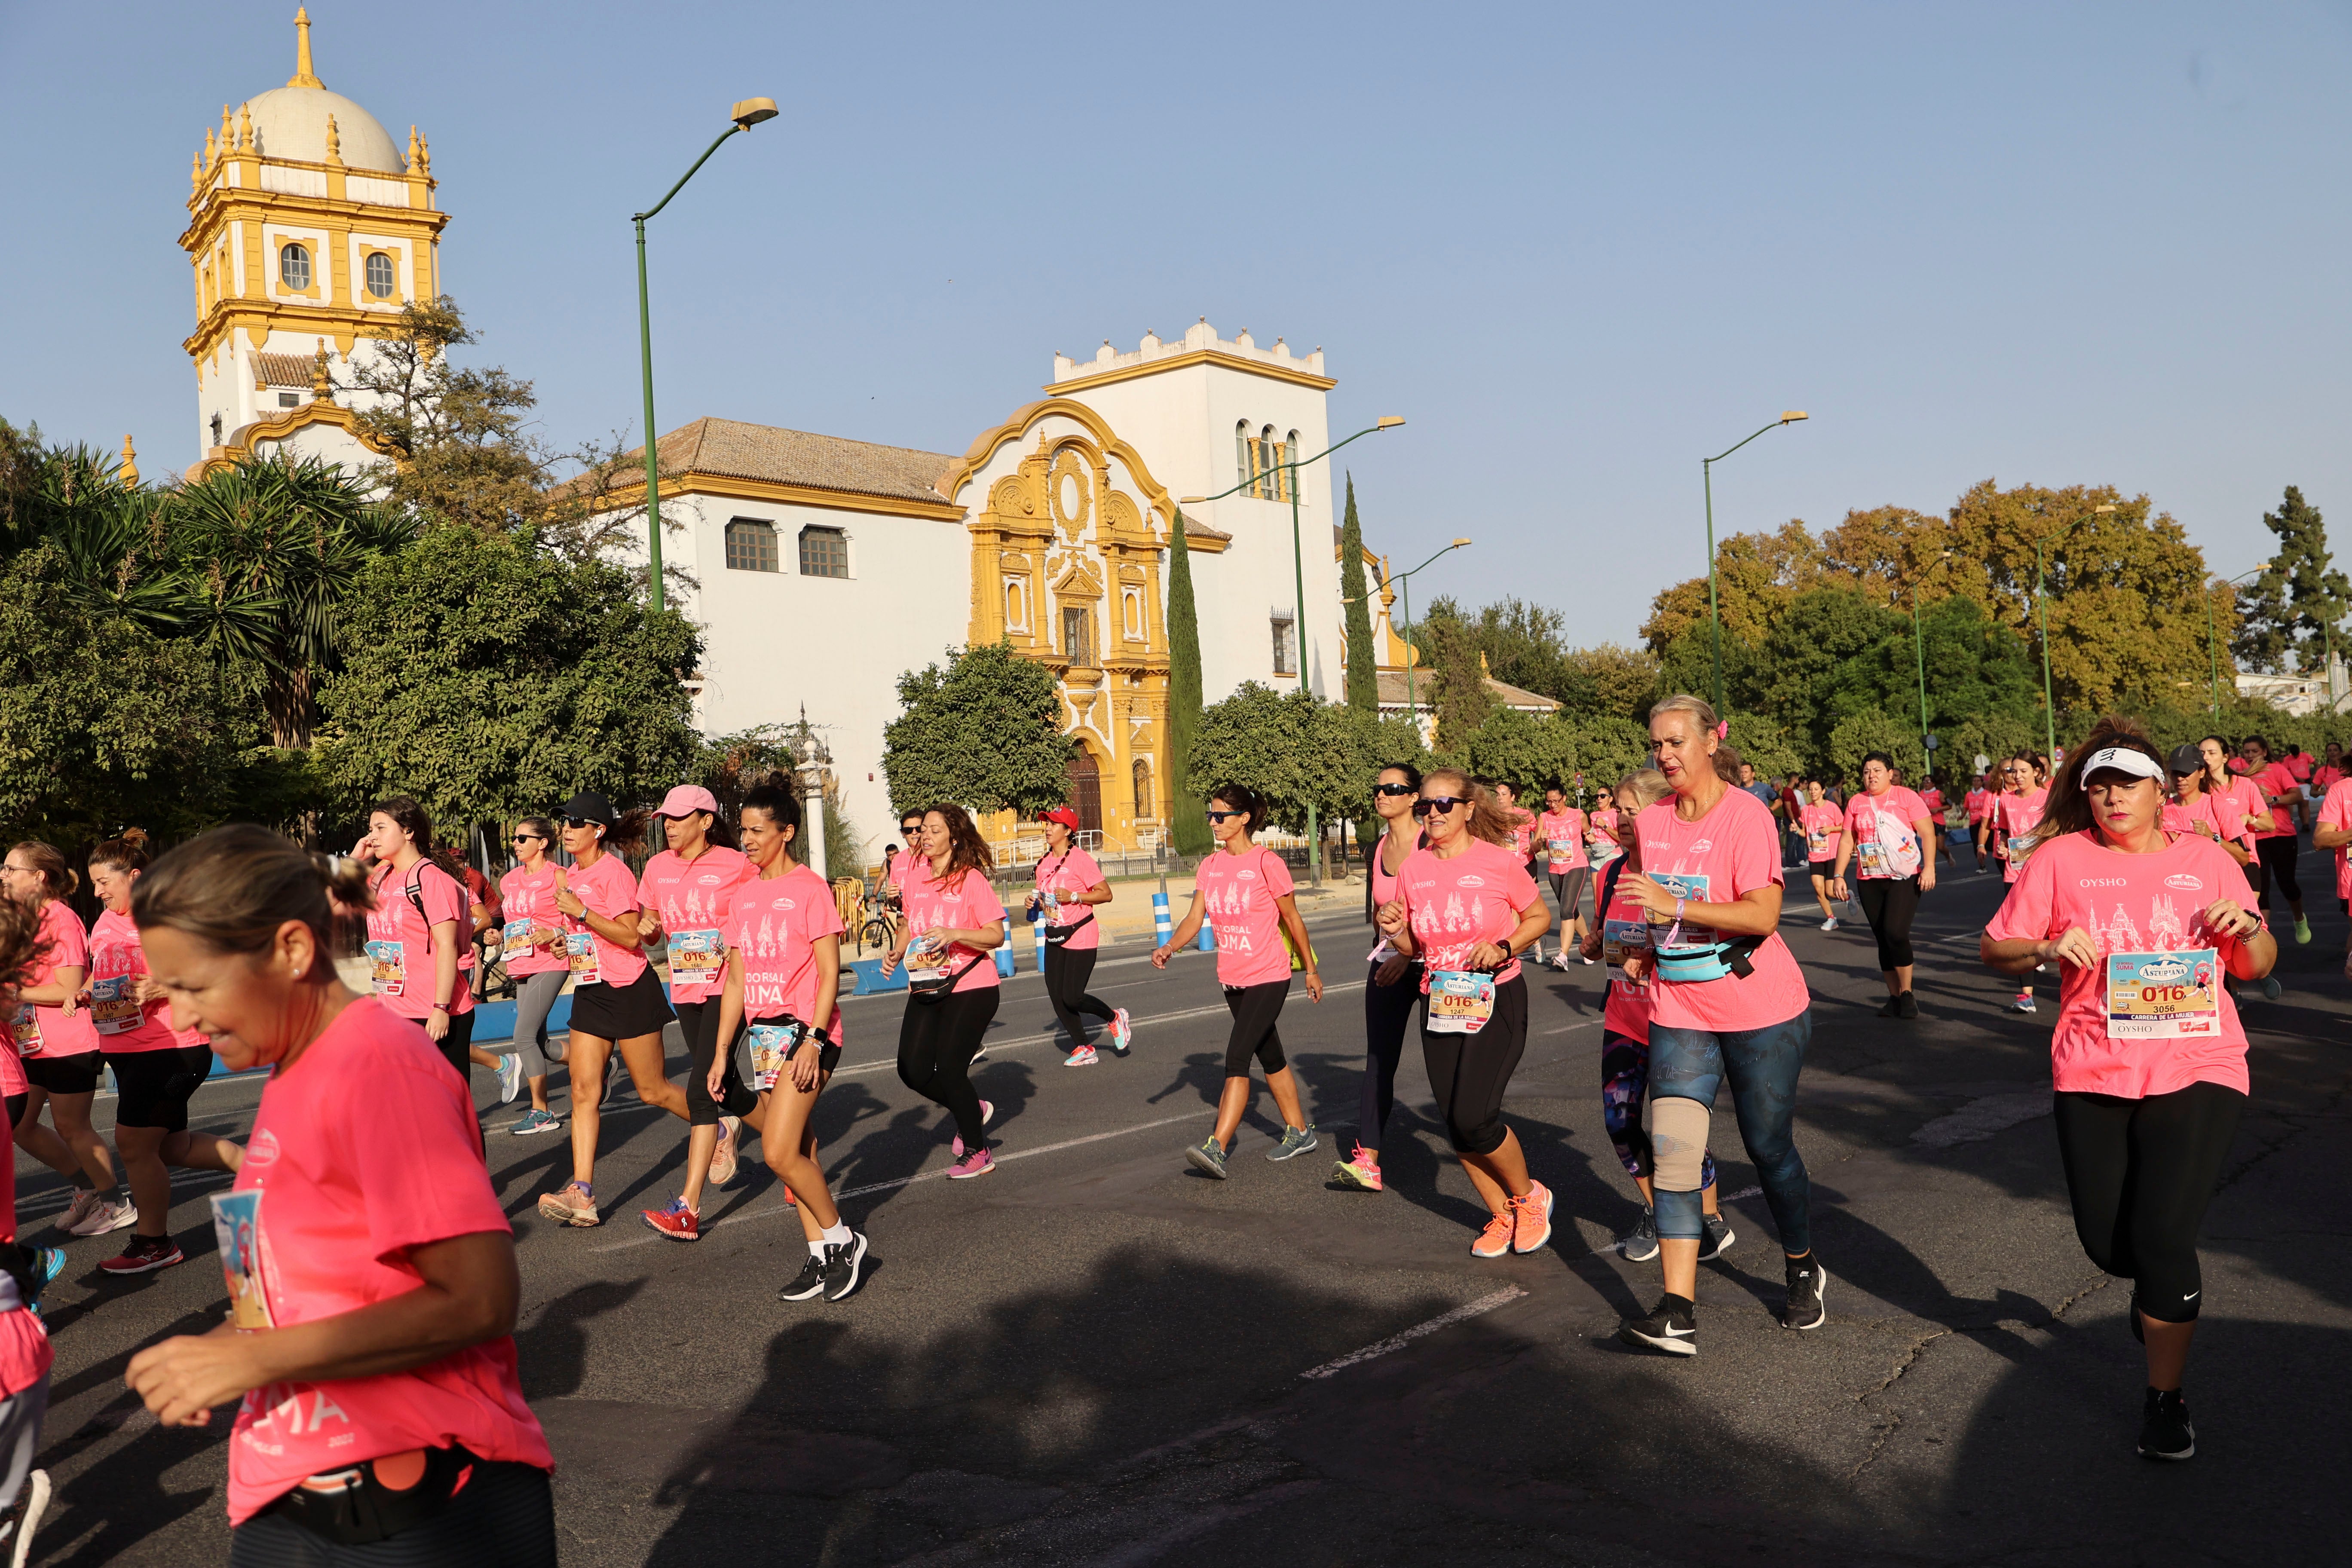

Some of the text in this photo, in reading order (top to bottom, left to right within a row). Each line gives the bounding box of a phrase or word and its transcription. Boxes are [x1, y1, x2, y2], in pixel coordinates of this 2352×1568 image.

[1412, 880, 1435, 890] OYSHO
[2080, 878, 2126, 888] OYSHO
[2168, 879, 2200, 888] ASTURIANA
[742, 901, 755, 910] SHO
[511, 935, 523, 943] 016
[1216, 932, 1252, 950] SUMA
[569, 955, 582, 964] 16
[684, 952, 706, 962] 016
[917, 952, 937, 962] 016
[378, 961, 389, 972] 016
[2143, 968, 2184, 976] ASTURIANA
[746, 972, 786, 983] DORSAL
[1446, 982, 1473, 990] ASTURIANA
[2142, 985, 2184, 1001] 016
[1444, 995, 1472, 1007] 016
[97, 1001, 117, 1012] 016
[2153, 1005, 2174, 1013] 3056
[12, 1024, 24, 1034] 16
